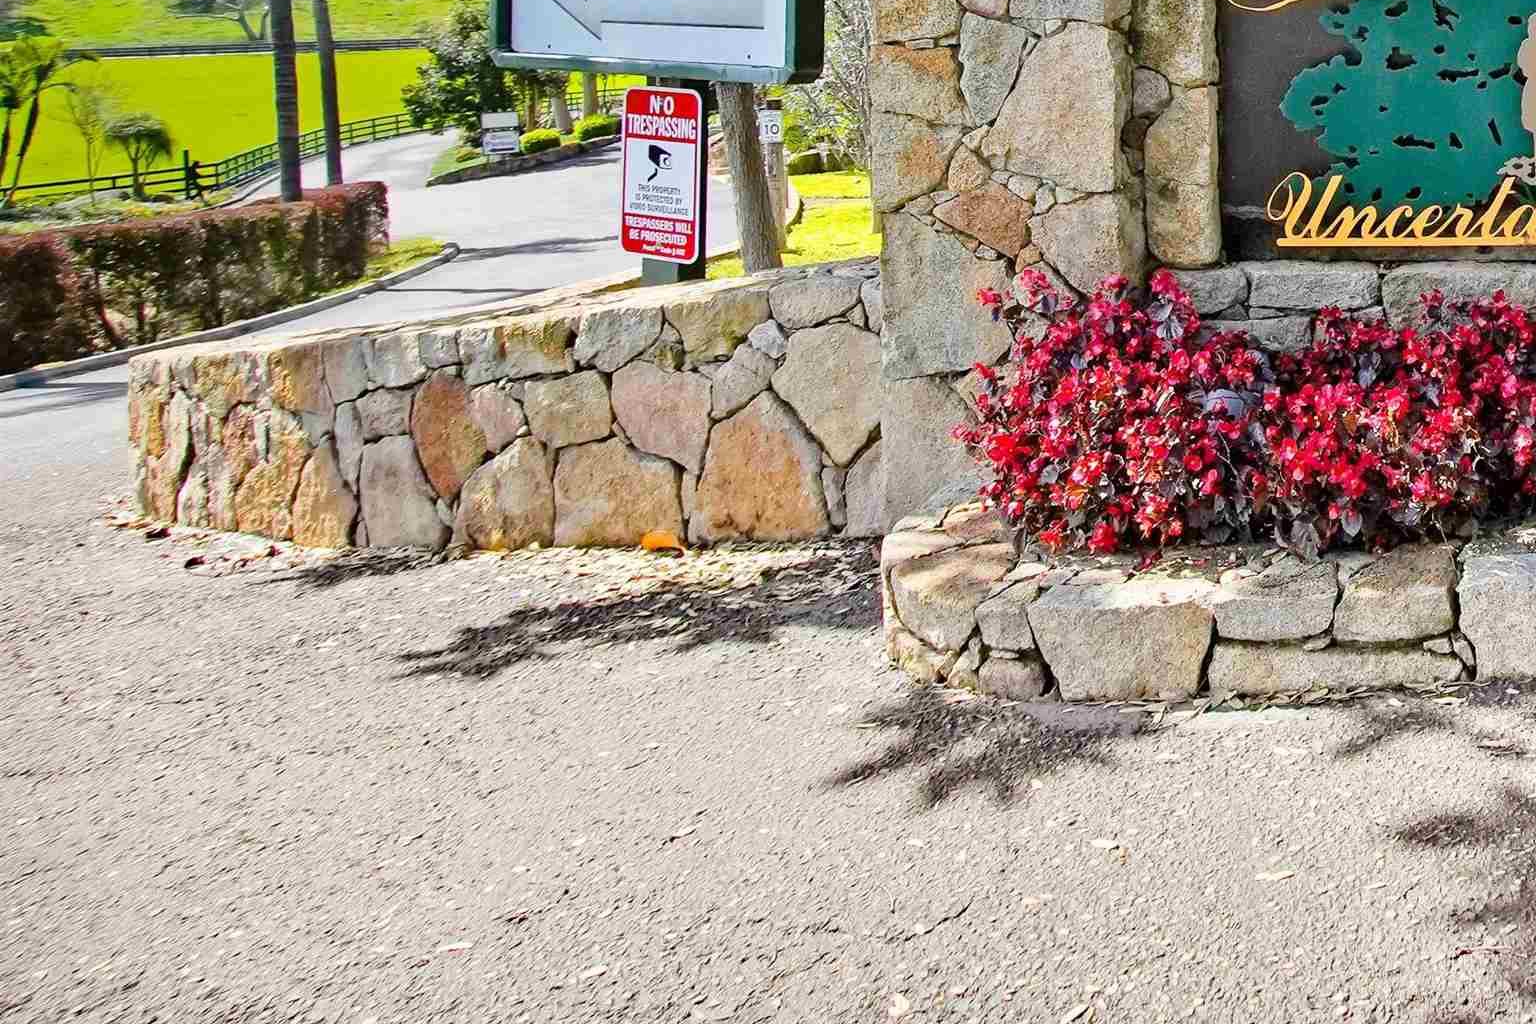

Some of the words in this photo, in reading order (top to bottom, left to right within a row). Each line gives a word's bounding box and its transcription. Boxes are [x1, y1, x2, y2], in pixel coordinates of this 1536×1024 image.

[649, 94, 675, 115] NO
[627, 113, 697, 140] TRESPASSING
[652, 184, 681, 195] PROPERTY
[641, 193, 674, 205] PROTECTED
[675, 197, 683, 206] BY
[647, 203, 689, 216] SURVEILLANCE
[625, 215, 674, 231] TRESPASSERS
[674, 222, 693, 234] WILL
[629, 228, 640, 240] BE
[640, 229, 688, 246] PROSECUTED
